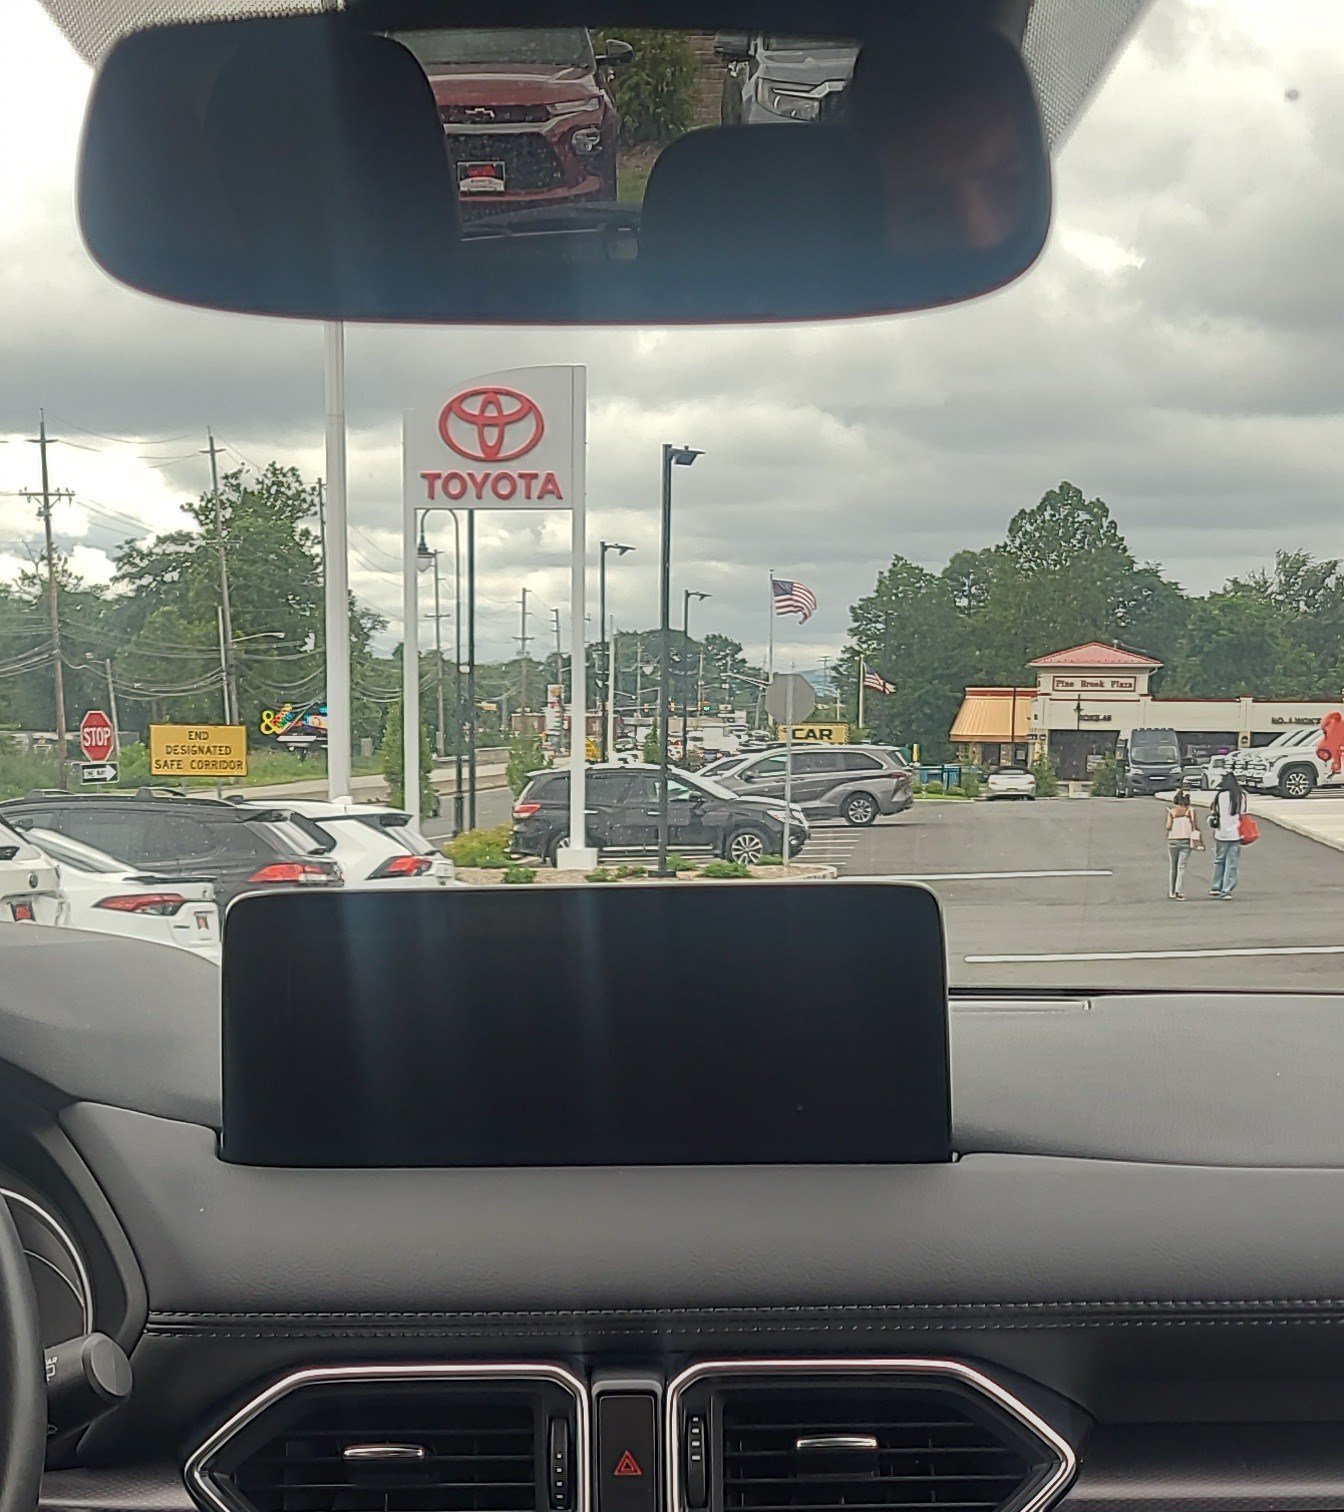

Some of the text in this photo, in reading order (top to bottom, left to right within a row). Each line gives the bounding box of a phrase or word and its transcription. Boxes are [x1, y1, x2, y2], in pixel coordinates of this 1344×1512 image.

[420, 470, 563, 500] TOYOTA
[1056, 680, 1074, 688] Pine
[1110, 680, 1133, 688] Plaza
[83, 727, 111, 747] STOP
[188, 730, 209, 741] END
[792, 728, 833, 740] CAR
[165, 745, 232, 756] DESIGNATED
[154, 759, 244, 770] SAFE CORRIDOR
